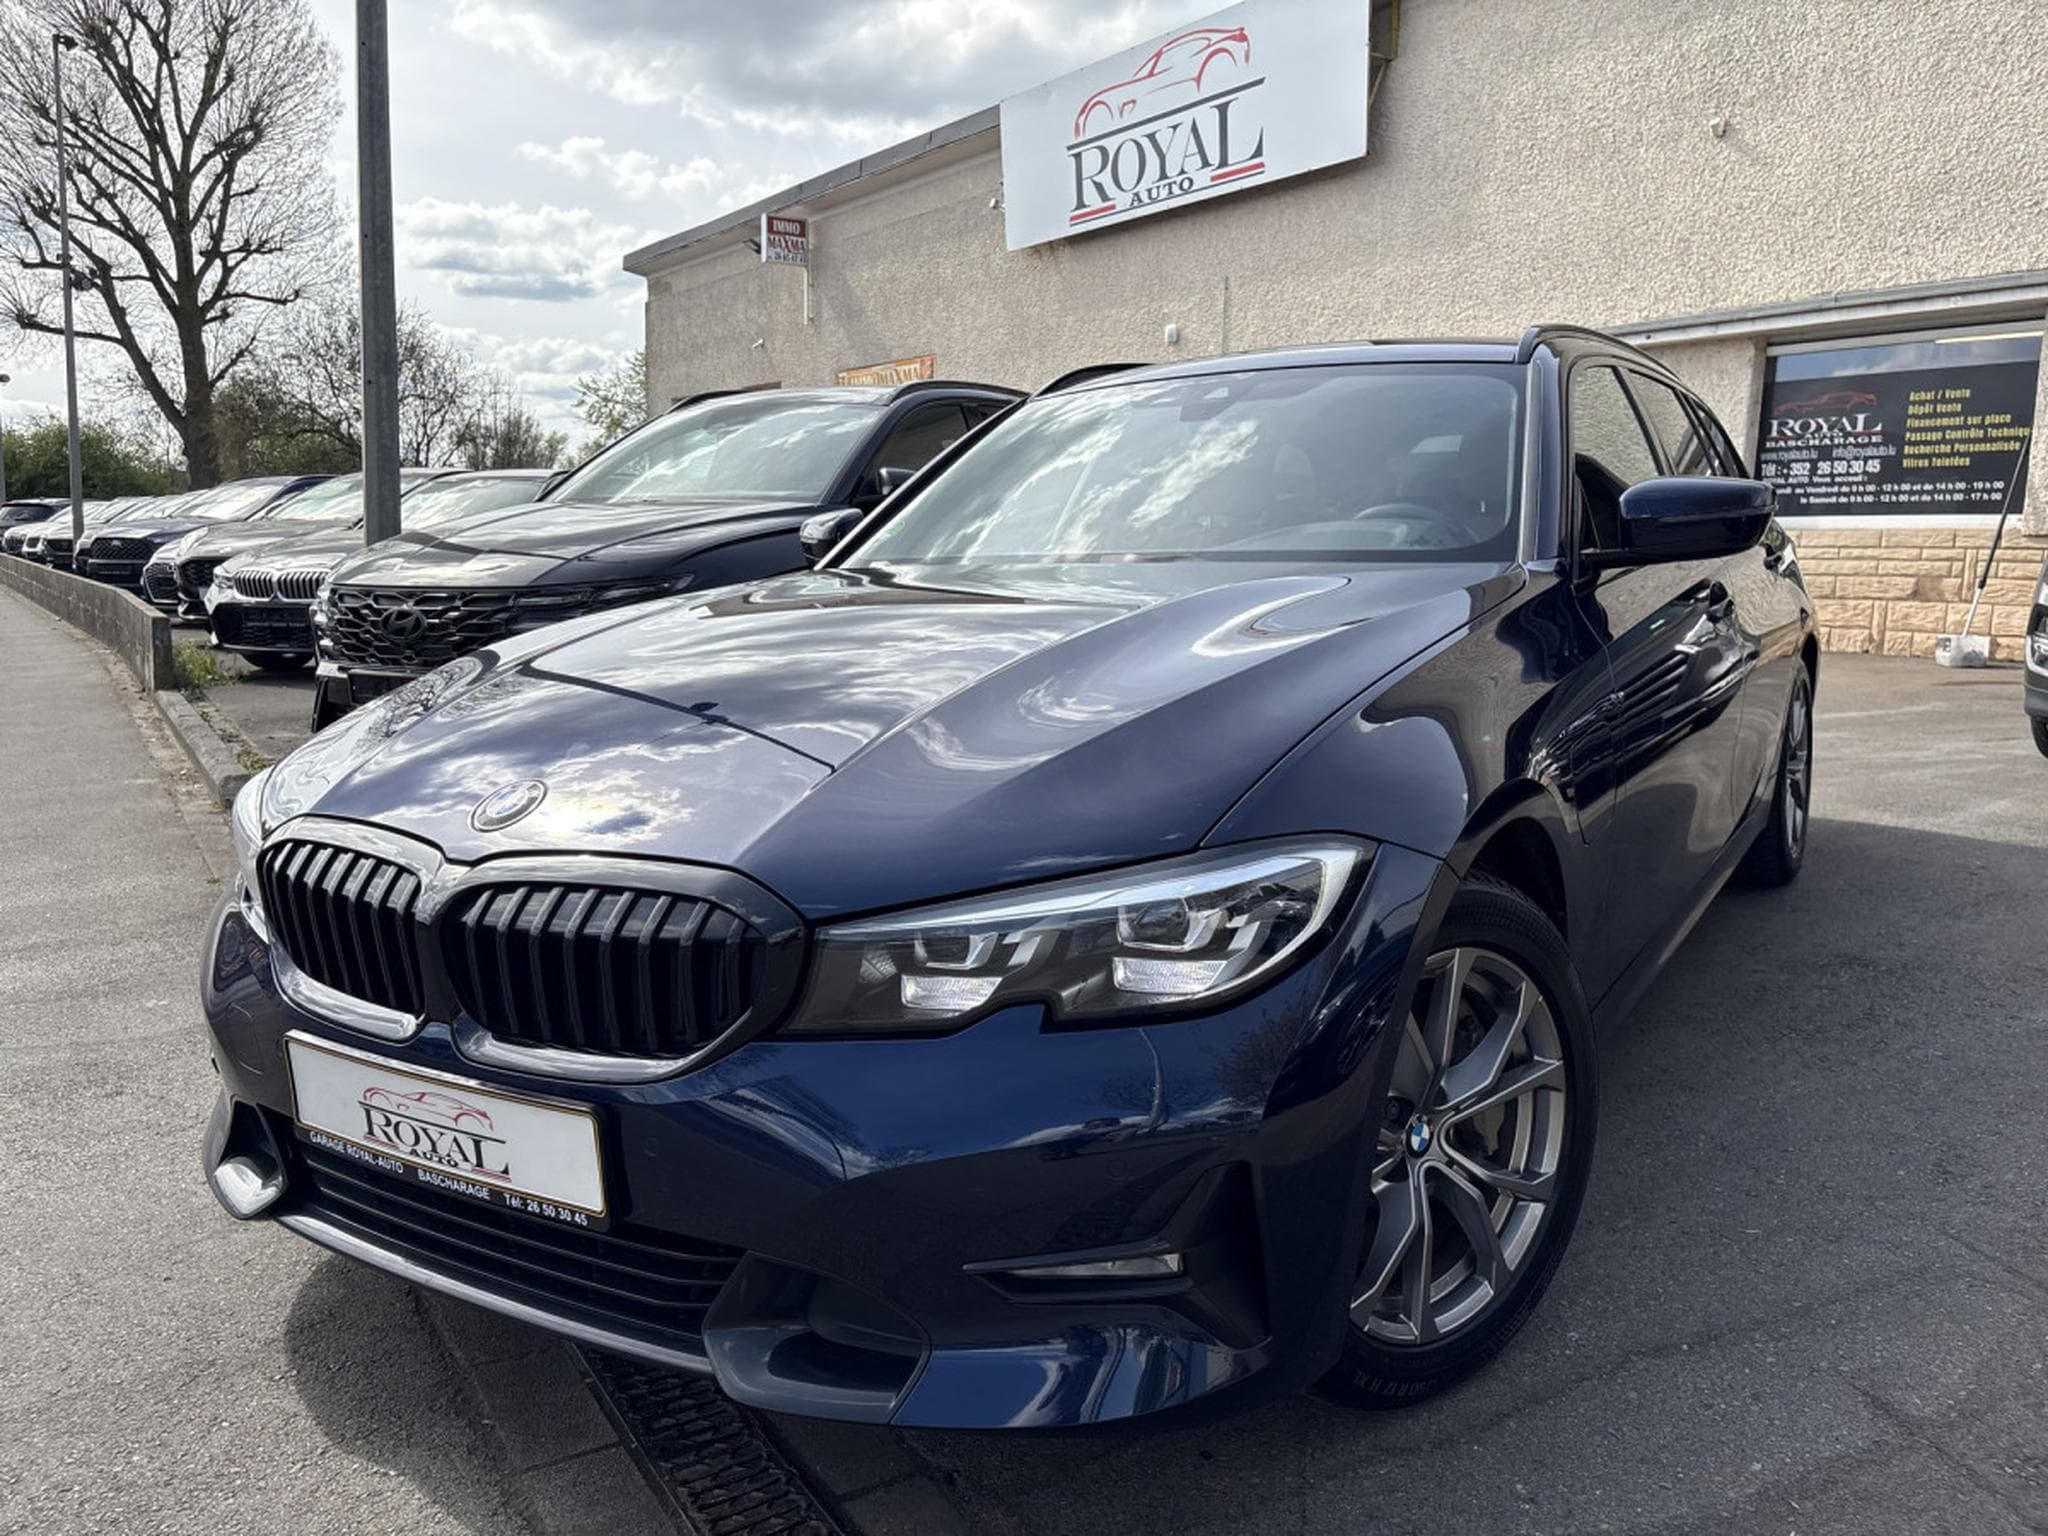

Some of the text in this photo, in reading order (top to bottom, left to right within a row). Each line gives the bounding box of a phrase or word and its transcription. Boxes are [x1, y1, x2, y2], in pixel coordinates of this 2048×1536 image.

[1070, 98, 1264, 211] ROYAL
[1129, 176, 1194, 207] AUTO
[773, 219, 800, 234] IMMO
[1909, 391, 1935, 401] Achat
[1945, 388, 1971, 399] Vente
[1936, 403, 1962, 413] Vente
[1768, 413, 1882, 437] ROYAL
[1907, 413, 2012, 428] Financement sur place
[1766, 435, 1882, 448] BASCHARAGE
[1905, 430, 1943, 441] Passage
[1945, 427, 1984, 439] Contrôle
[1904, 440, 2021, 455] Recherche Personnalisée
[1817, 461, 1832, 475] 26
[1833, 461, 1848, 474] 50
[1849, 460, 1863, 474] 30
[1865, 459, 1881, 473] 45
[1902, 456, 1970, 468] Vitres Teintées
[1993, 480, 2004, 489] 00
[1990, 491, 2002, 500] 00
[362, 1107, 510, 1175] ROYAL
[409, 1149, 459, 1167] AUTO
[310, 1131, 344, 1153] GARAGE
[346, 1144, 404, 1173] ROYAL-AUTO
[417, 1168, 491, 1199] BASCHARAGE
[527, 1199, 540, 1213] 26
[543, 1203, 556, 1217] 50
[558, 1207, 571, 1221] 30
[574, 1212, 588, 1226] 45
